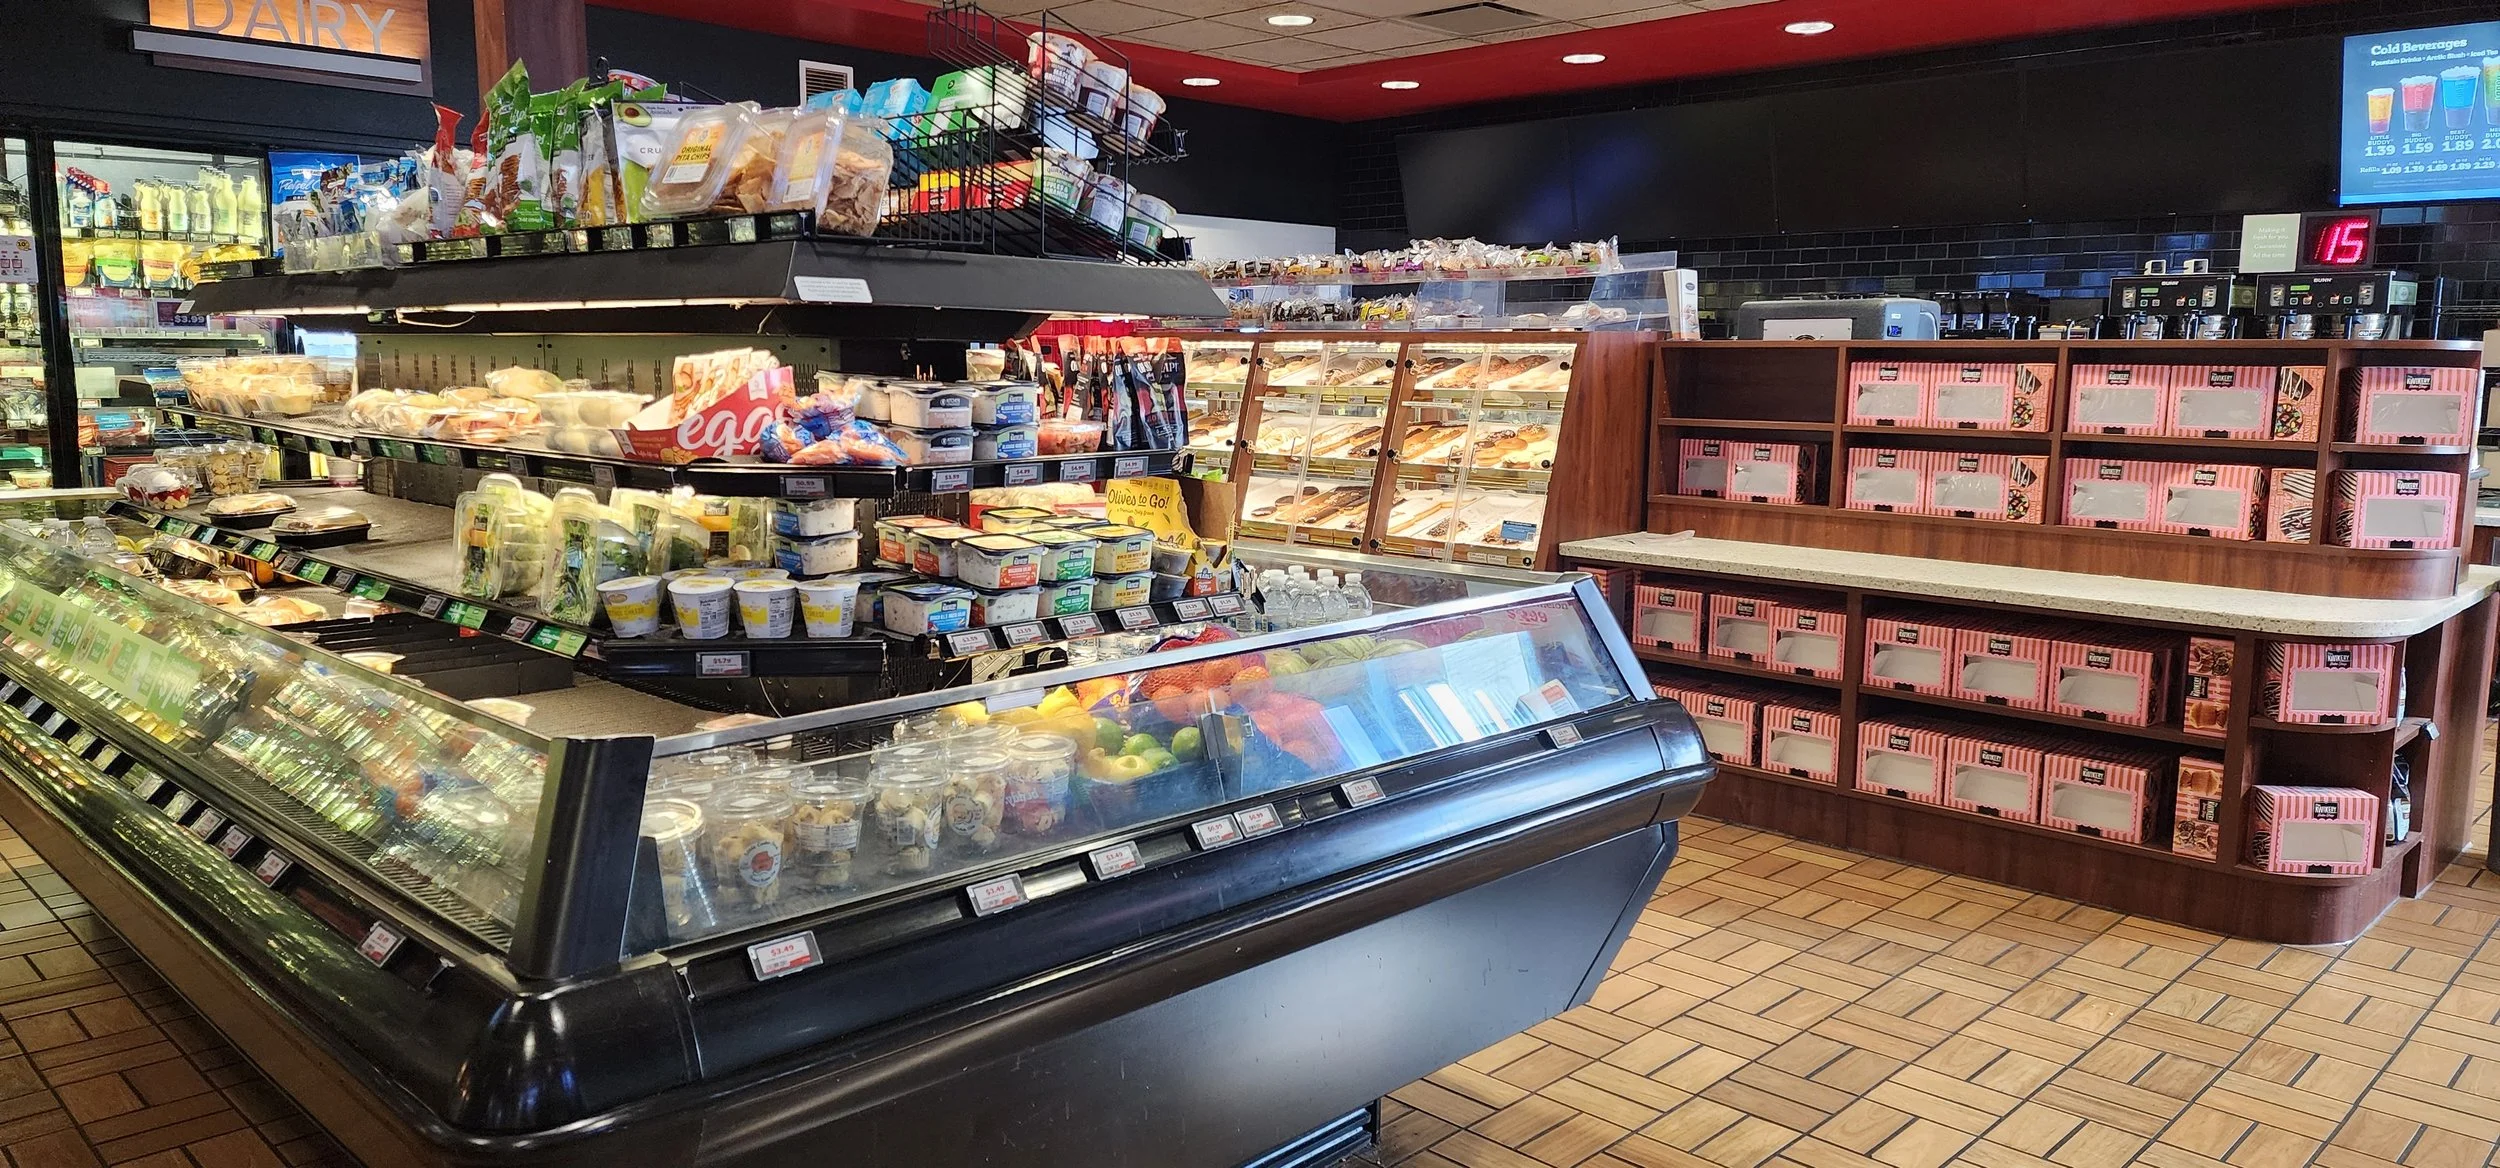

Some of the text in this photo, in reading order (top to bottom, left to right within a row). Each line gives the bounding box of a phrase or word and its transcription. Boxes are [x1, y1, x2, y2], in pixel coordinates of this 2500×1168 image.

[185, 0, 396, 54] DAIRY
[2371, 39, 2468, 56] Cold Beverages
[2371, 57, 2400, 67] Fountain
[2400, 55, 2422, 64] Drinks
[2426, 53, 2446, 62] Arctic
[681, 144, 712, 154] ORIGINAL
[2365, 145, 2396, 157] 1.39
[2402, 142, 2434, 155] 1.59
[2442, 139, 2475, 152] 1.89
[691, 152, 710, 161] CHIPS
[2360, 166, 2381, 174] Refills
[2381, 166, 2402, 175] 1.09
[2404, 164, 2425, 174] 1.39
[2426, 163, 2448, 172] 1.69
[2473, 160, 2496, 170] 2.29
[279, 178, 314, 194] Pretzel
[2325, 222, 2369, 264] 15
[174, 314, 205, 324] $3.99
[1107, 488, 1170, 509] Olives to Go!
[2315, 806, 2337, 814] KWIKERY
[770, 944, 795, 957] $3.49
